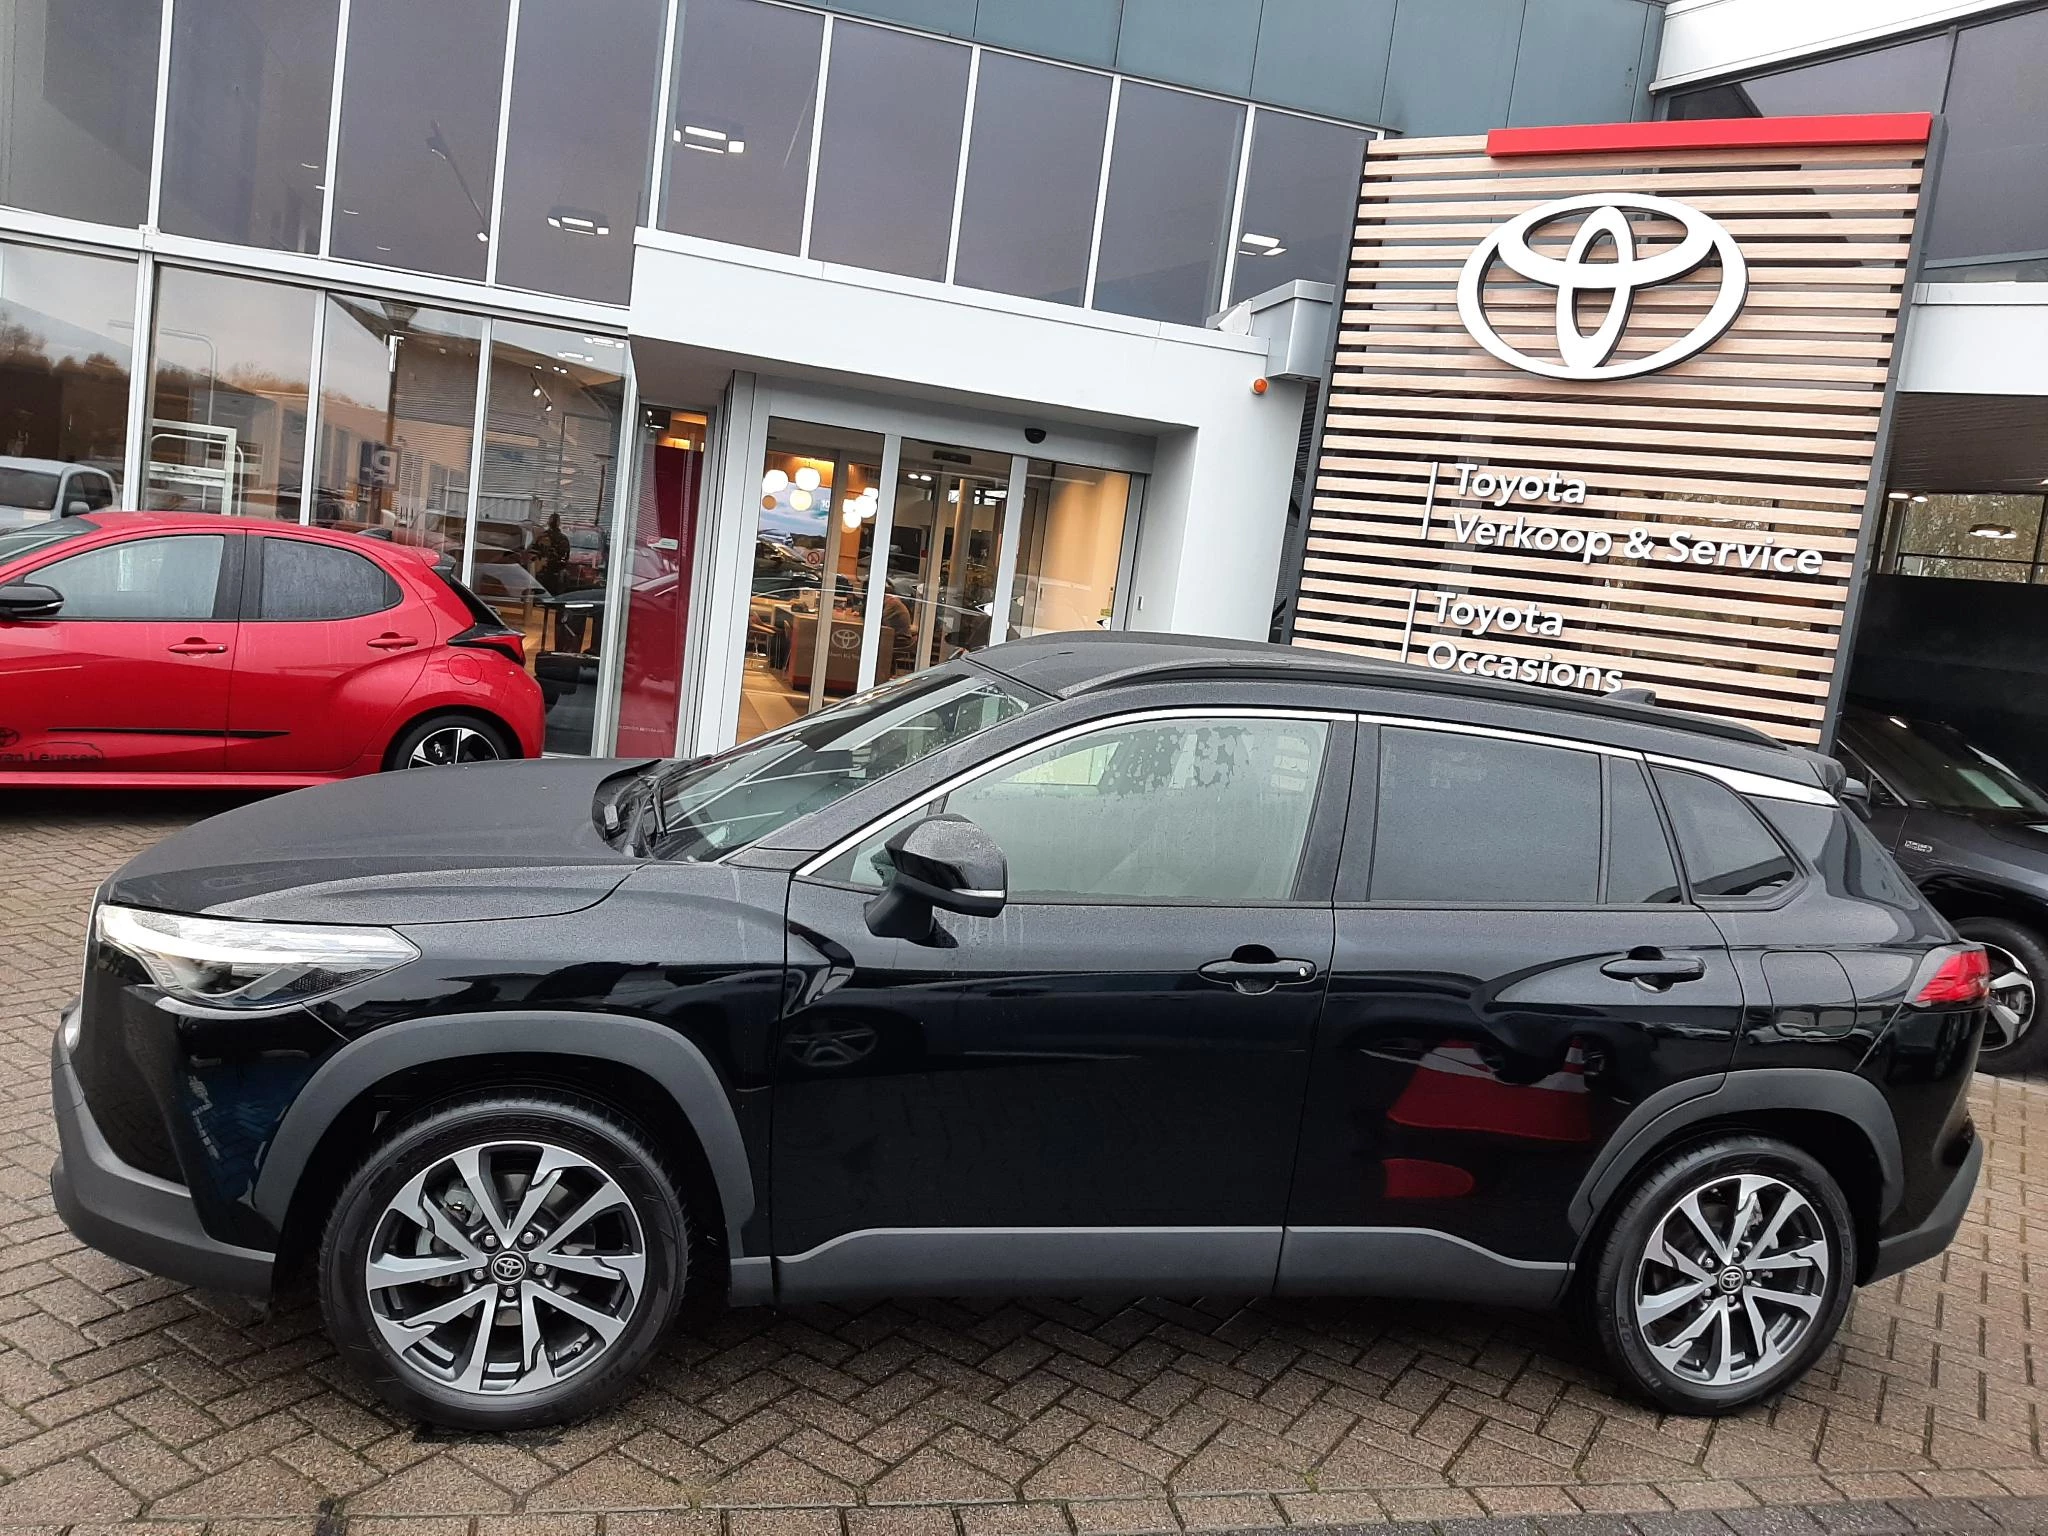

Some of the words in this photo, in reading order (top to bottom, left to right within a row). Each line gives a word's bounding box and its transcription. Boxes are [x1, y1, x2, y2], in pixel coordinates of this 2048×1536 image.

[1455, 463, 1587, 505] Toyota
[1454, 514, 1612, 564] Verkoop
[1623, 527, 1655, 560] &
[1667, 530, 1823, 575] Service
[1436, 592, 1564, 636] Toyota
[1427, 642, 1623, 693] Occasions
